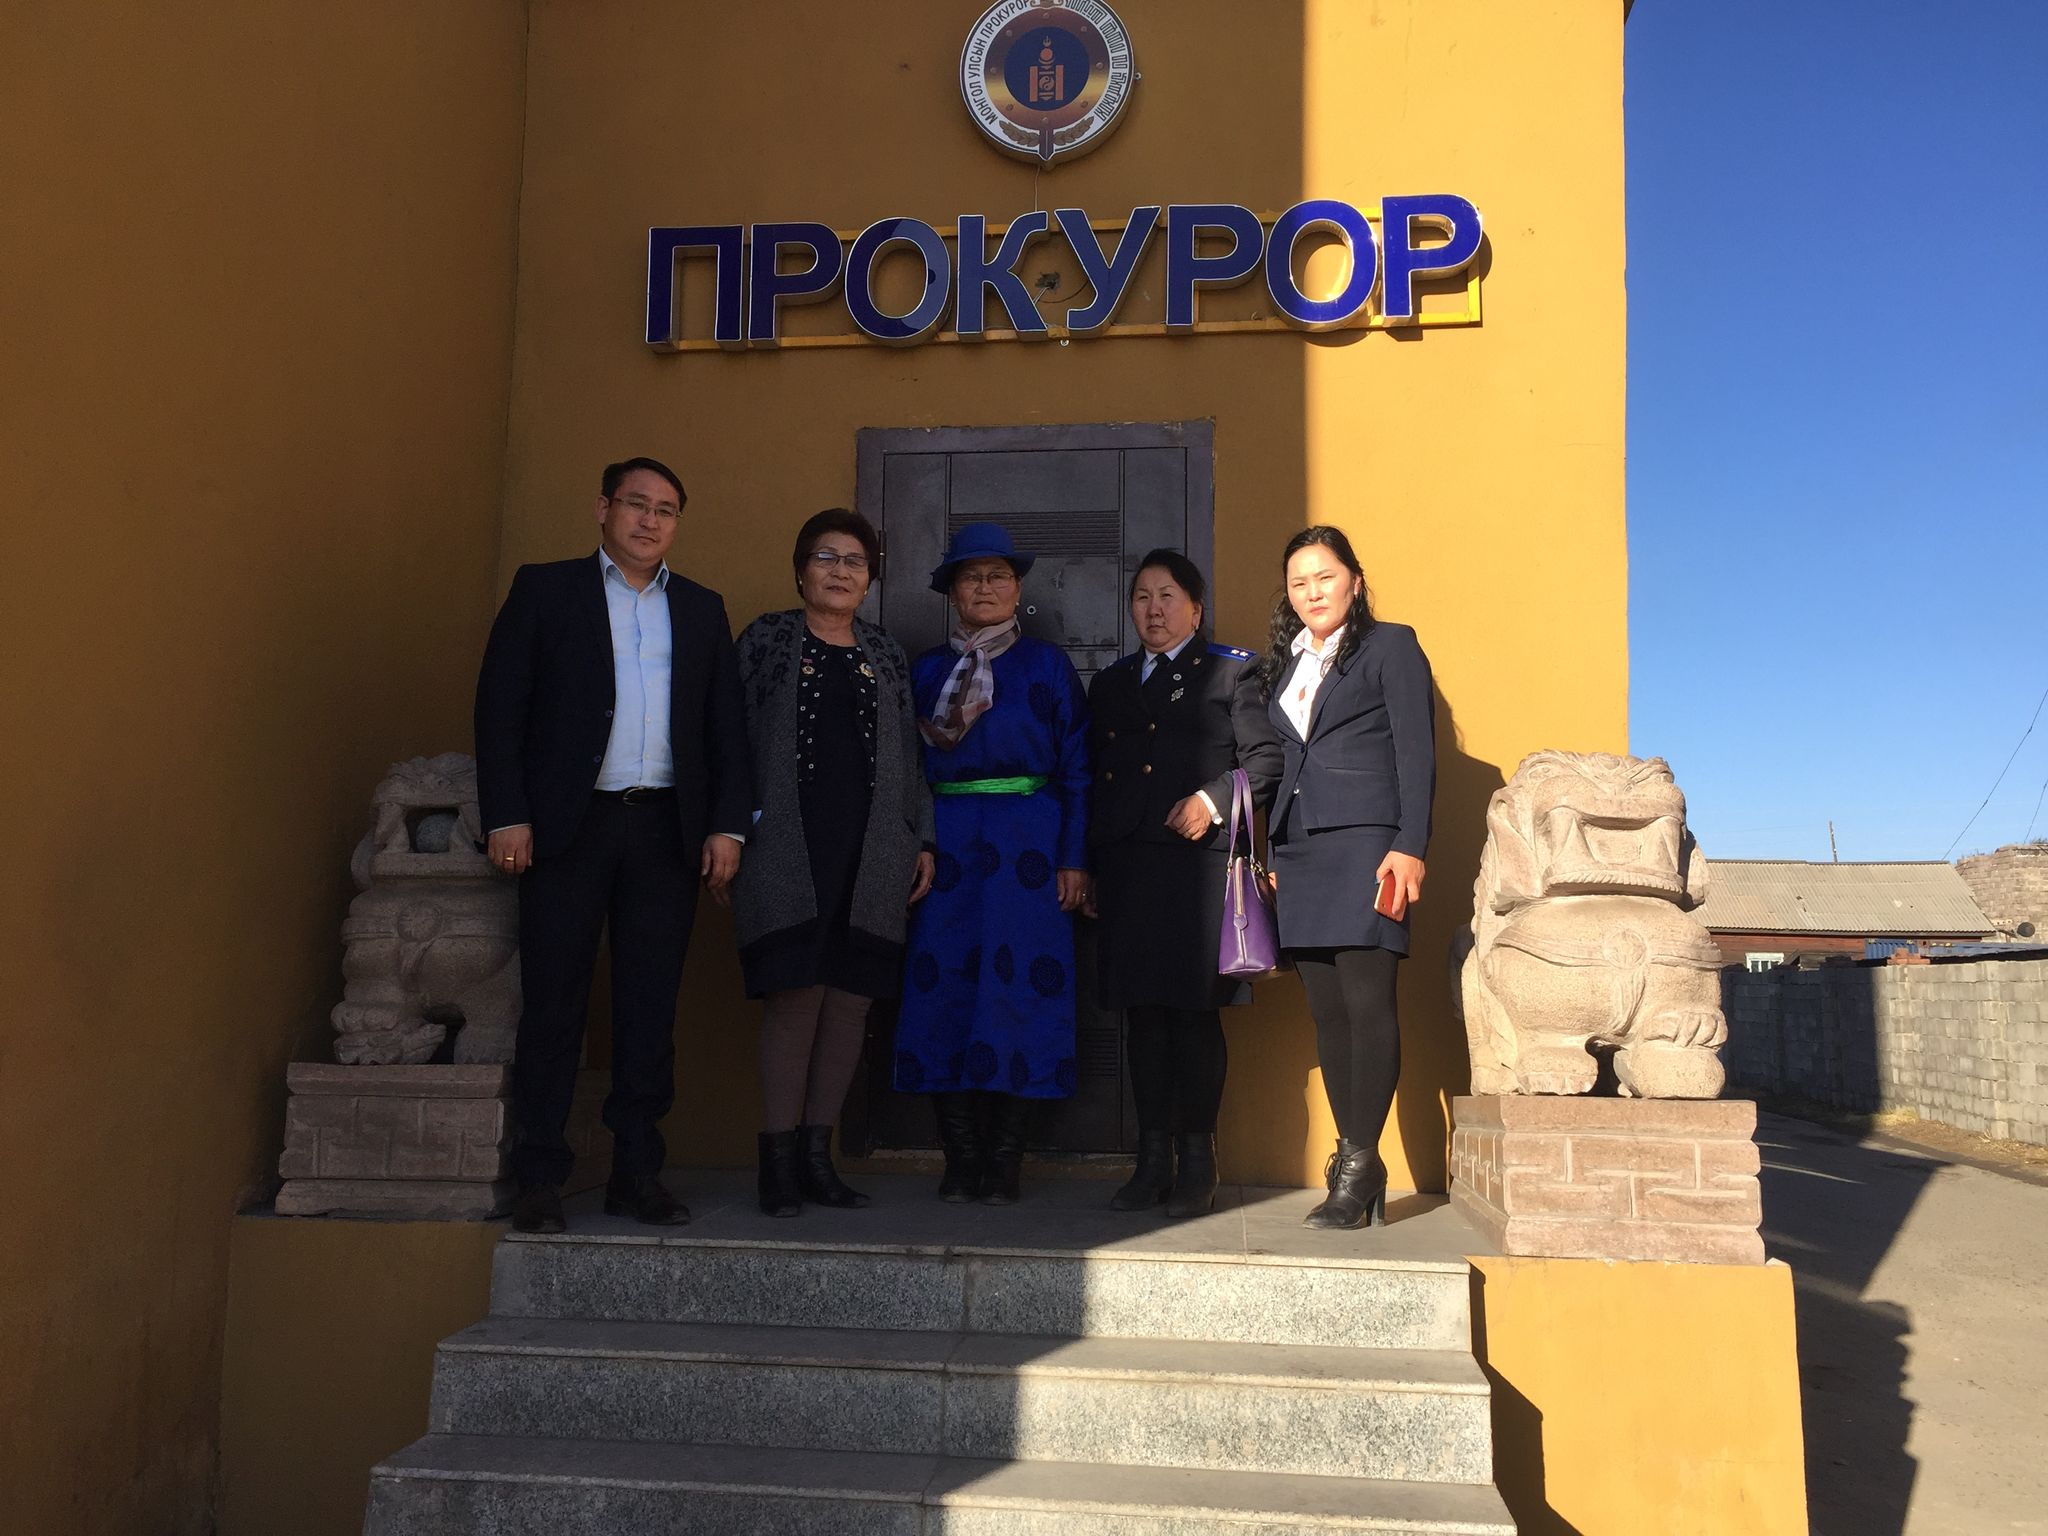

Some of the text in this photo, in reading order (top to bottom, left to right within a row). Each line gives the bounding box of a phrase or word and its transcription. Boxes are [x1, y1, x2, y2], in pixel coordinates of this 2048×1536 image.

[968, 38, 988, 79] УЛСЫН
[968, 80, 999, 125] МОНГОЛ
[646, 194, 1483, 344] ПРОКУРОР
